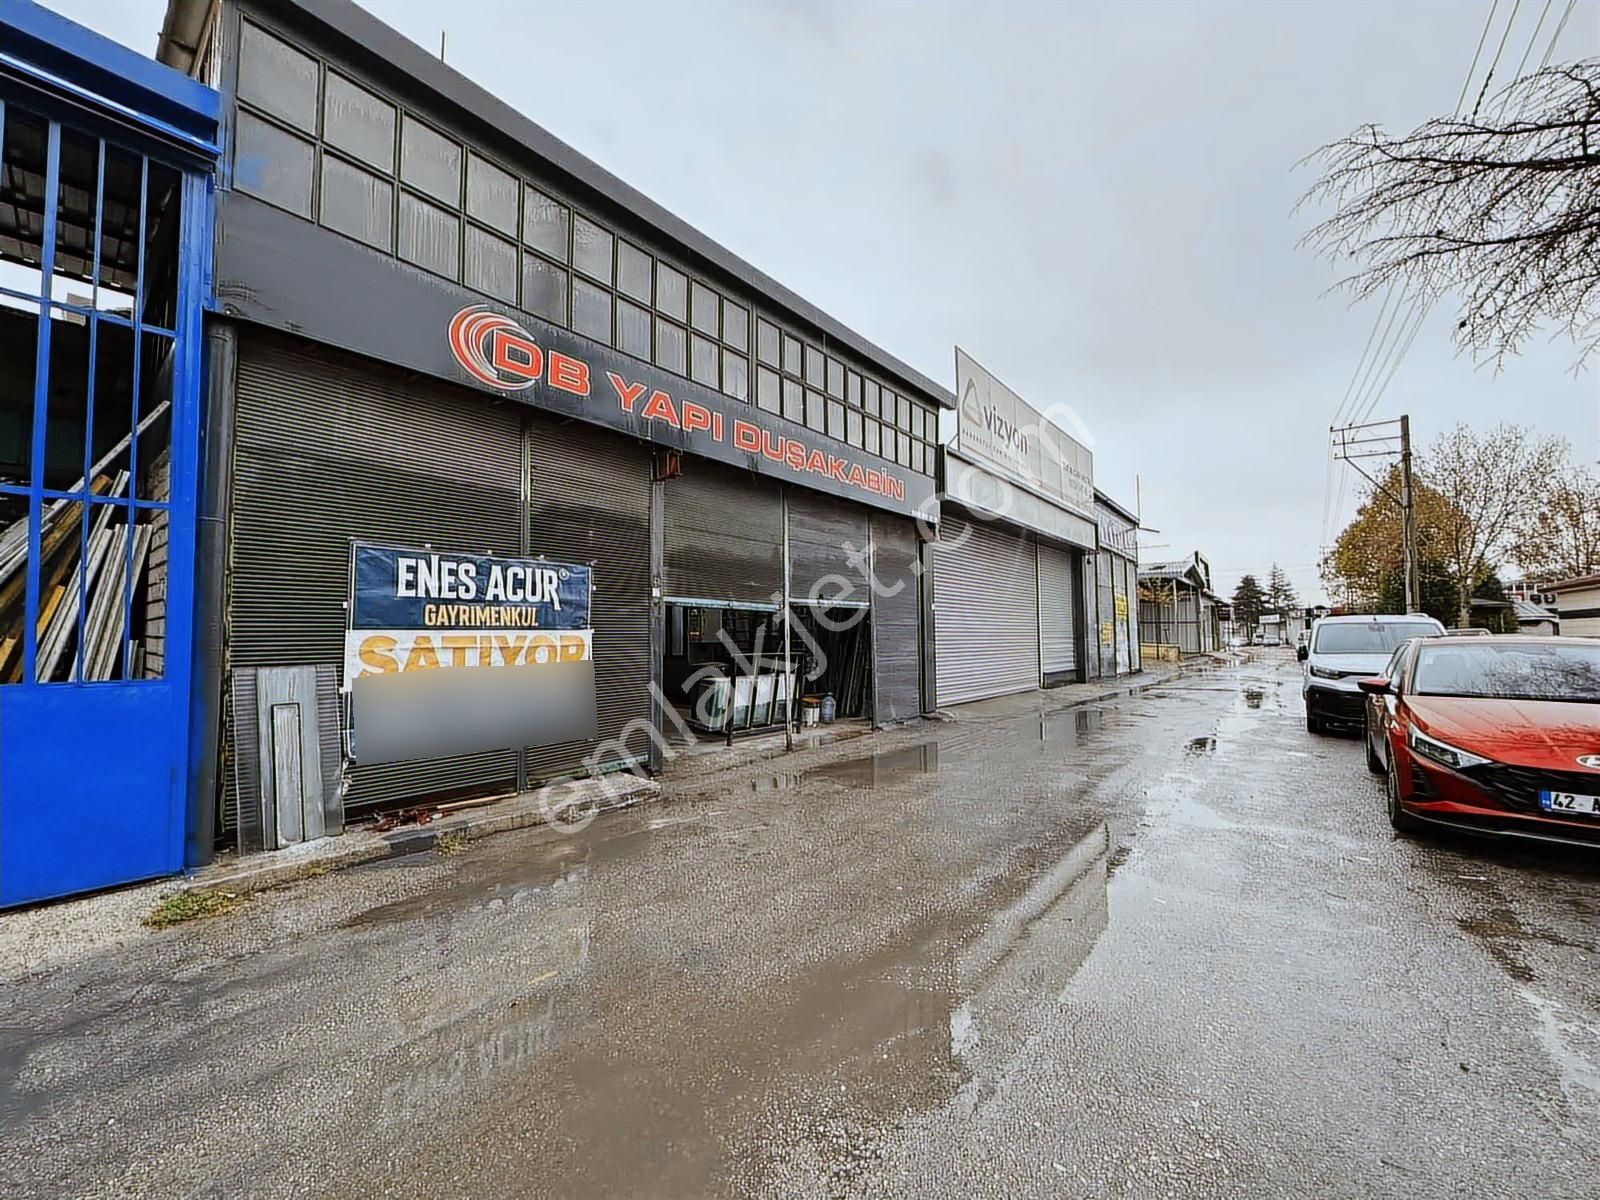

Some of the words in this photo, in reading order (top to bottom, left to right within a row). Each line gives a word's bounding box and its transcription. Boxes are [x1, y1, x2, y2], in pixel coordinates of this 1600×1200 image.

[494, 328, 591, 396] DB
[606, 371, 723, 441] YAPI
[733, 418, 905, 501] DUŞAKABİN
[983, 405, 1028, 455] vizyon
[397, 555, 477, 600] ENES
[424, 604, 539, 627] GAYRİMENKUL
[1553, 793, 1576, 809] 42
